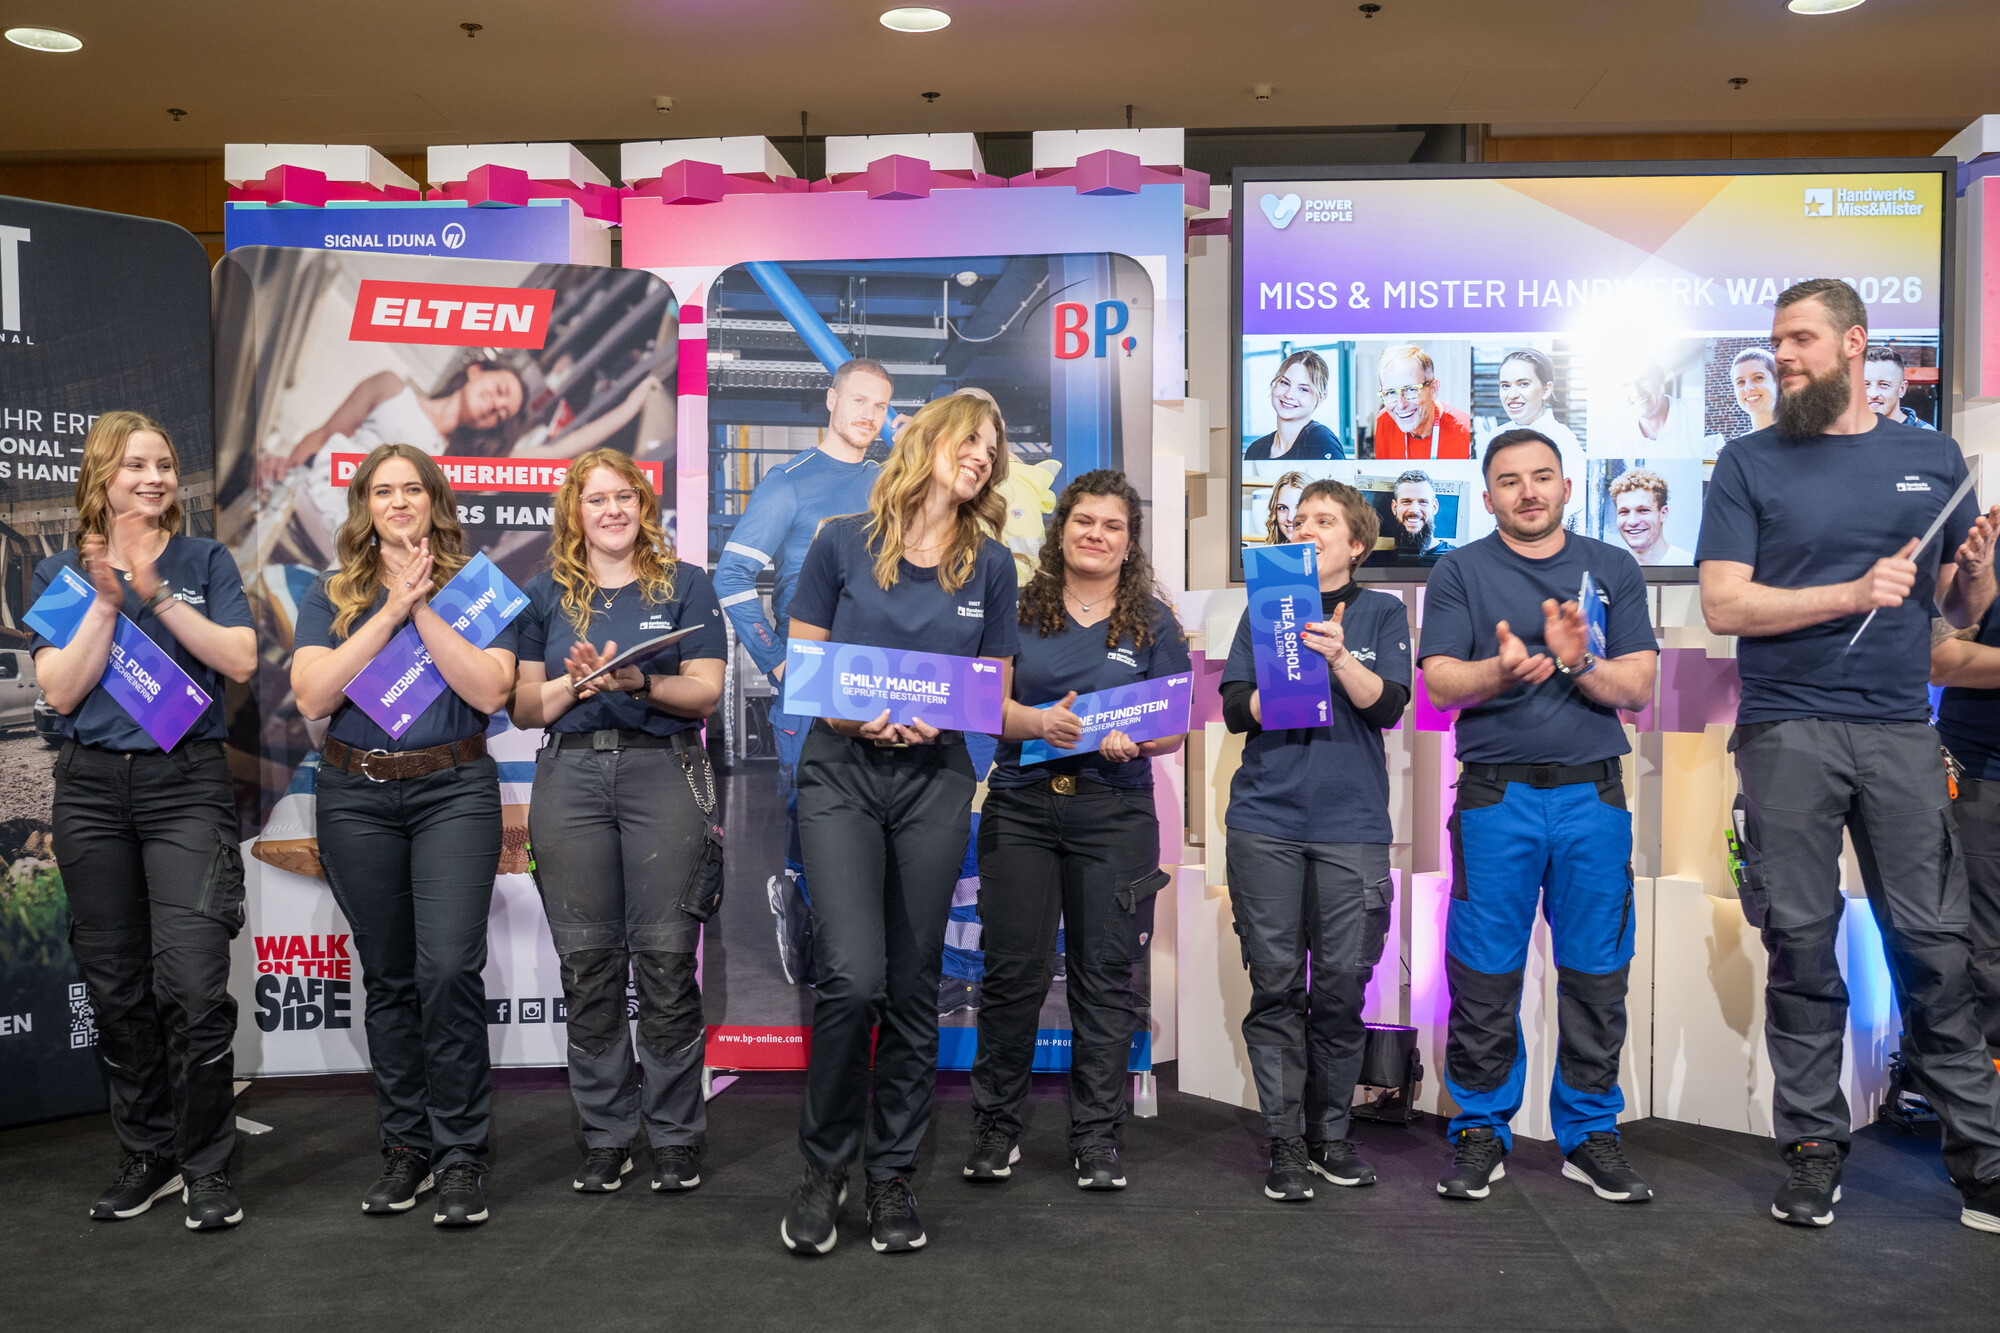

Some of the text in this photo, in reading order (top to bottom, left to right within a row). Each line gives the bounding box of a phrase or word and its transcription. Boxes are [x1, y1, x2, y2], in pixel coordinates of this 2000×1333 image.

[1305, 200, 1353, 210] POWER
[1836, 187, 1915, 202] Handwerks
[1305, 211, 1353, 222] PEOPLE
[1836, 201, 1924, 216] Miss&Mister
[324, 234, 437, 248] SIGNAL IDUNA
[1260, 281, 1338, 310] MISS
[1348, 281, 1371, 310] &
[1383, 280, 1506, 309] MISTER
[1725, 278, 1813, 306] WA
[371, 297, 535, 333] ELTEN
[437, 464, 567, 486] HERHEITS
[470, 586, 497, 621] ANNE
[1273, 621, 1285, 658] MÜLLERIN
[1280, 595, 1301, 681] THEA SCHOLZ
[111, 660, 154, 704] (SCHREINERIN)
[125, 658, 161, 696] FUCHS
[840, 672, 950, 696] EMILY MAICHLE
[843, 686, 947, 705] GEPRÜFTE BESTATTERIN
[1096, 699, 1169, 722] PFUNDSTEIN
[254, 934, 351, 961] WALK
[257, 959, 351, 980] ON THE
[718, 1033, 803, 1045] www.bp-online.com
[1035, 1039, 1072, 1047] UM-PROE
